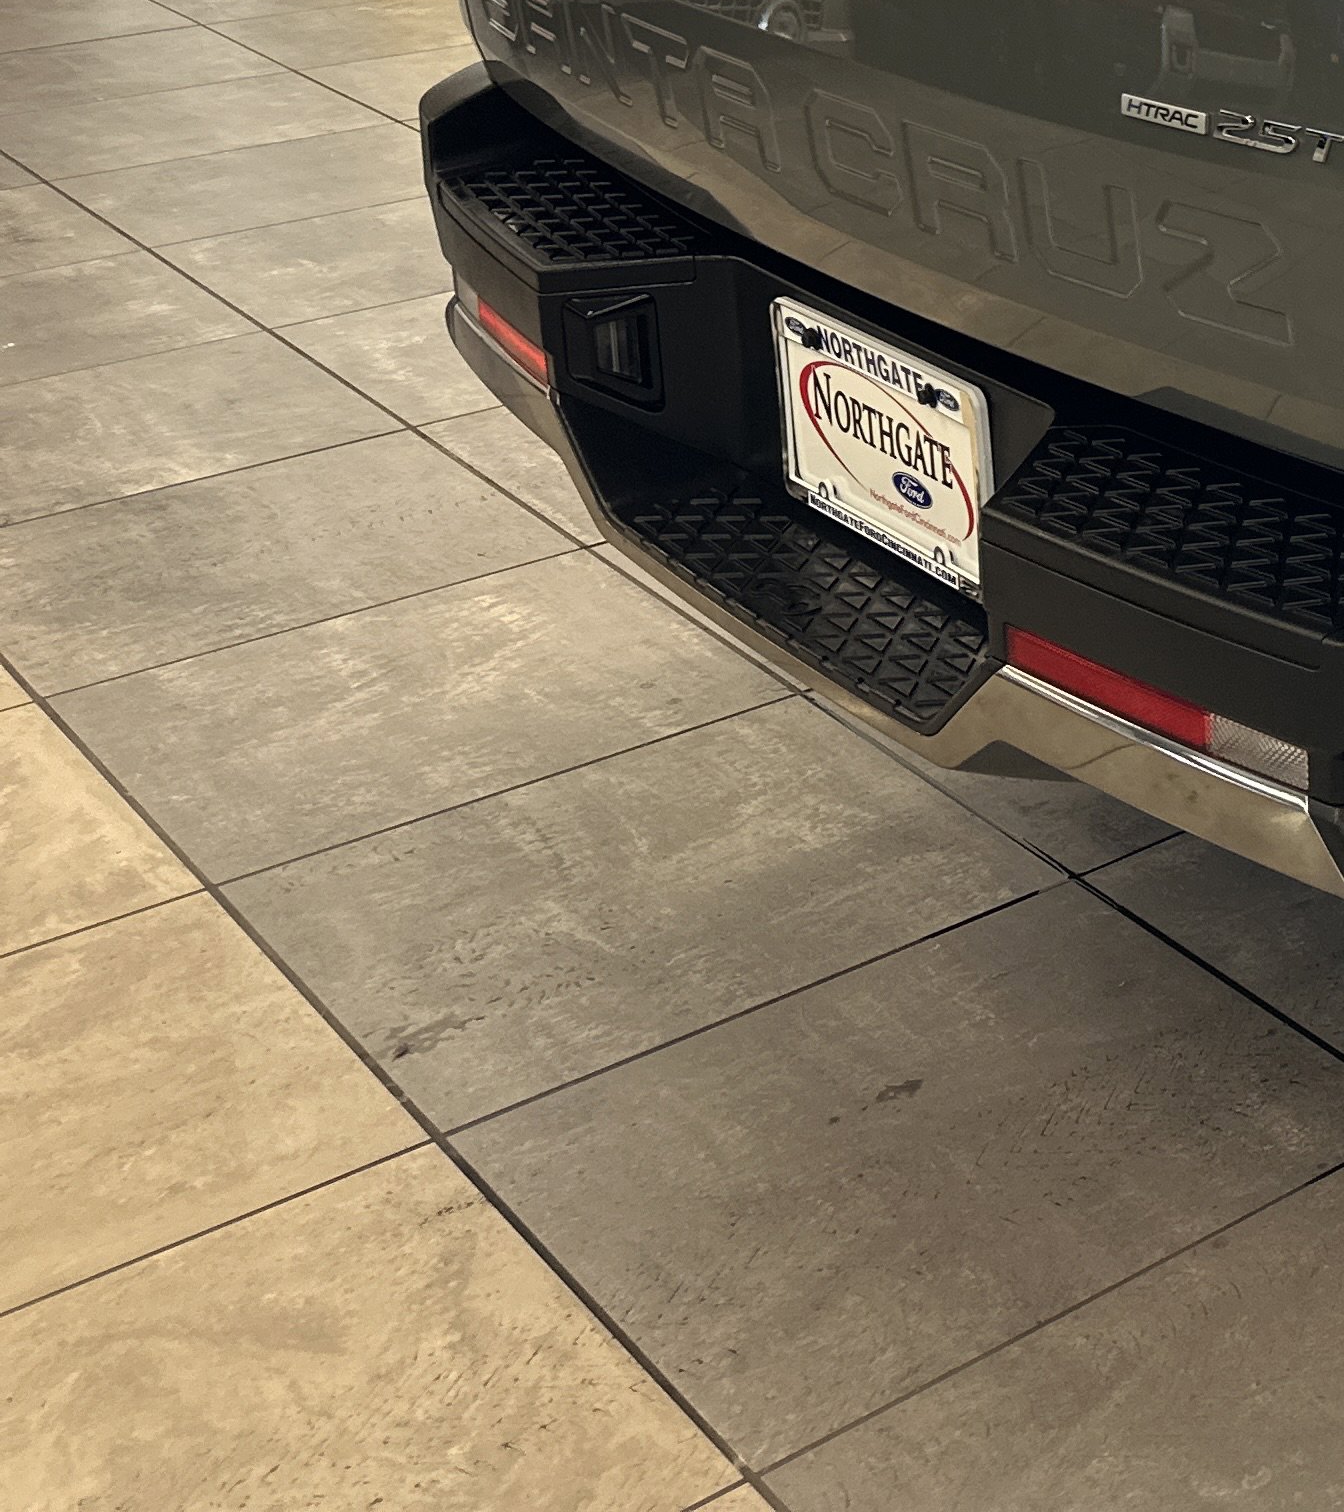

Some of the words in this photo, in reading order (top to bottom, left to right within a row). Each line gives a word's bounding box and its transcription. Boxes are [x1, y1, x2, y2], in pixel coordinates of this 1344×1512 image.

[1126, 98, 1200, 129] HTRAC
[817, 324, 925, 397] NORTHGATE
[811, 367, 954, 489] NORTHGATE
[896, 474, 928, 506] Ford
